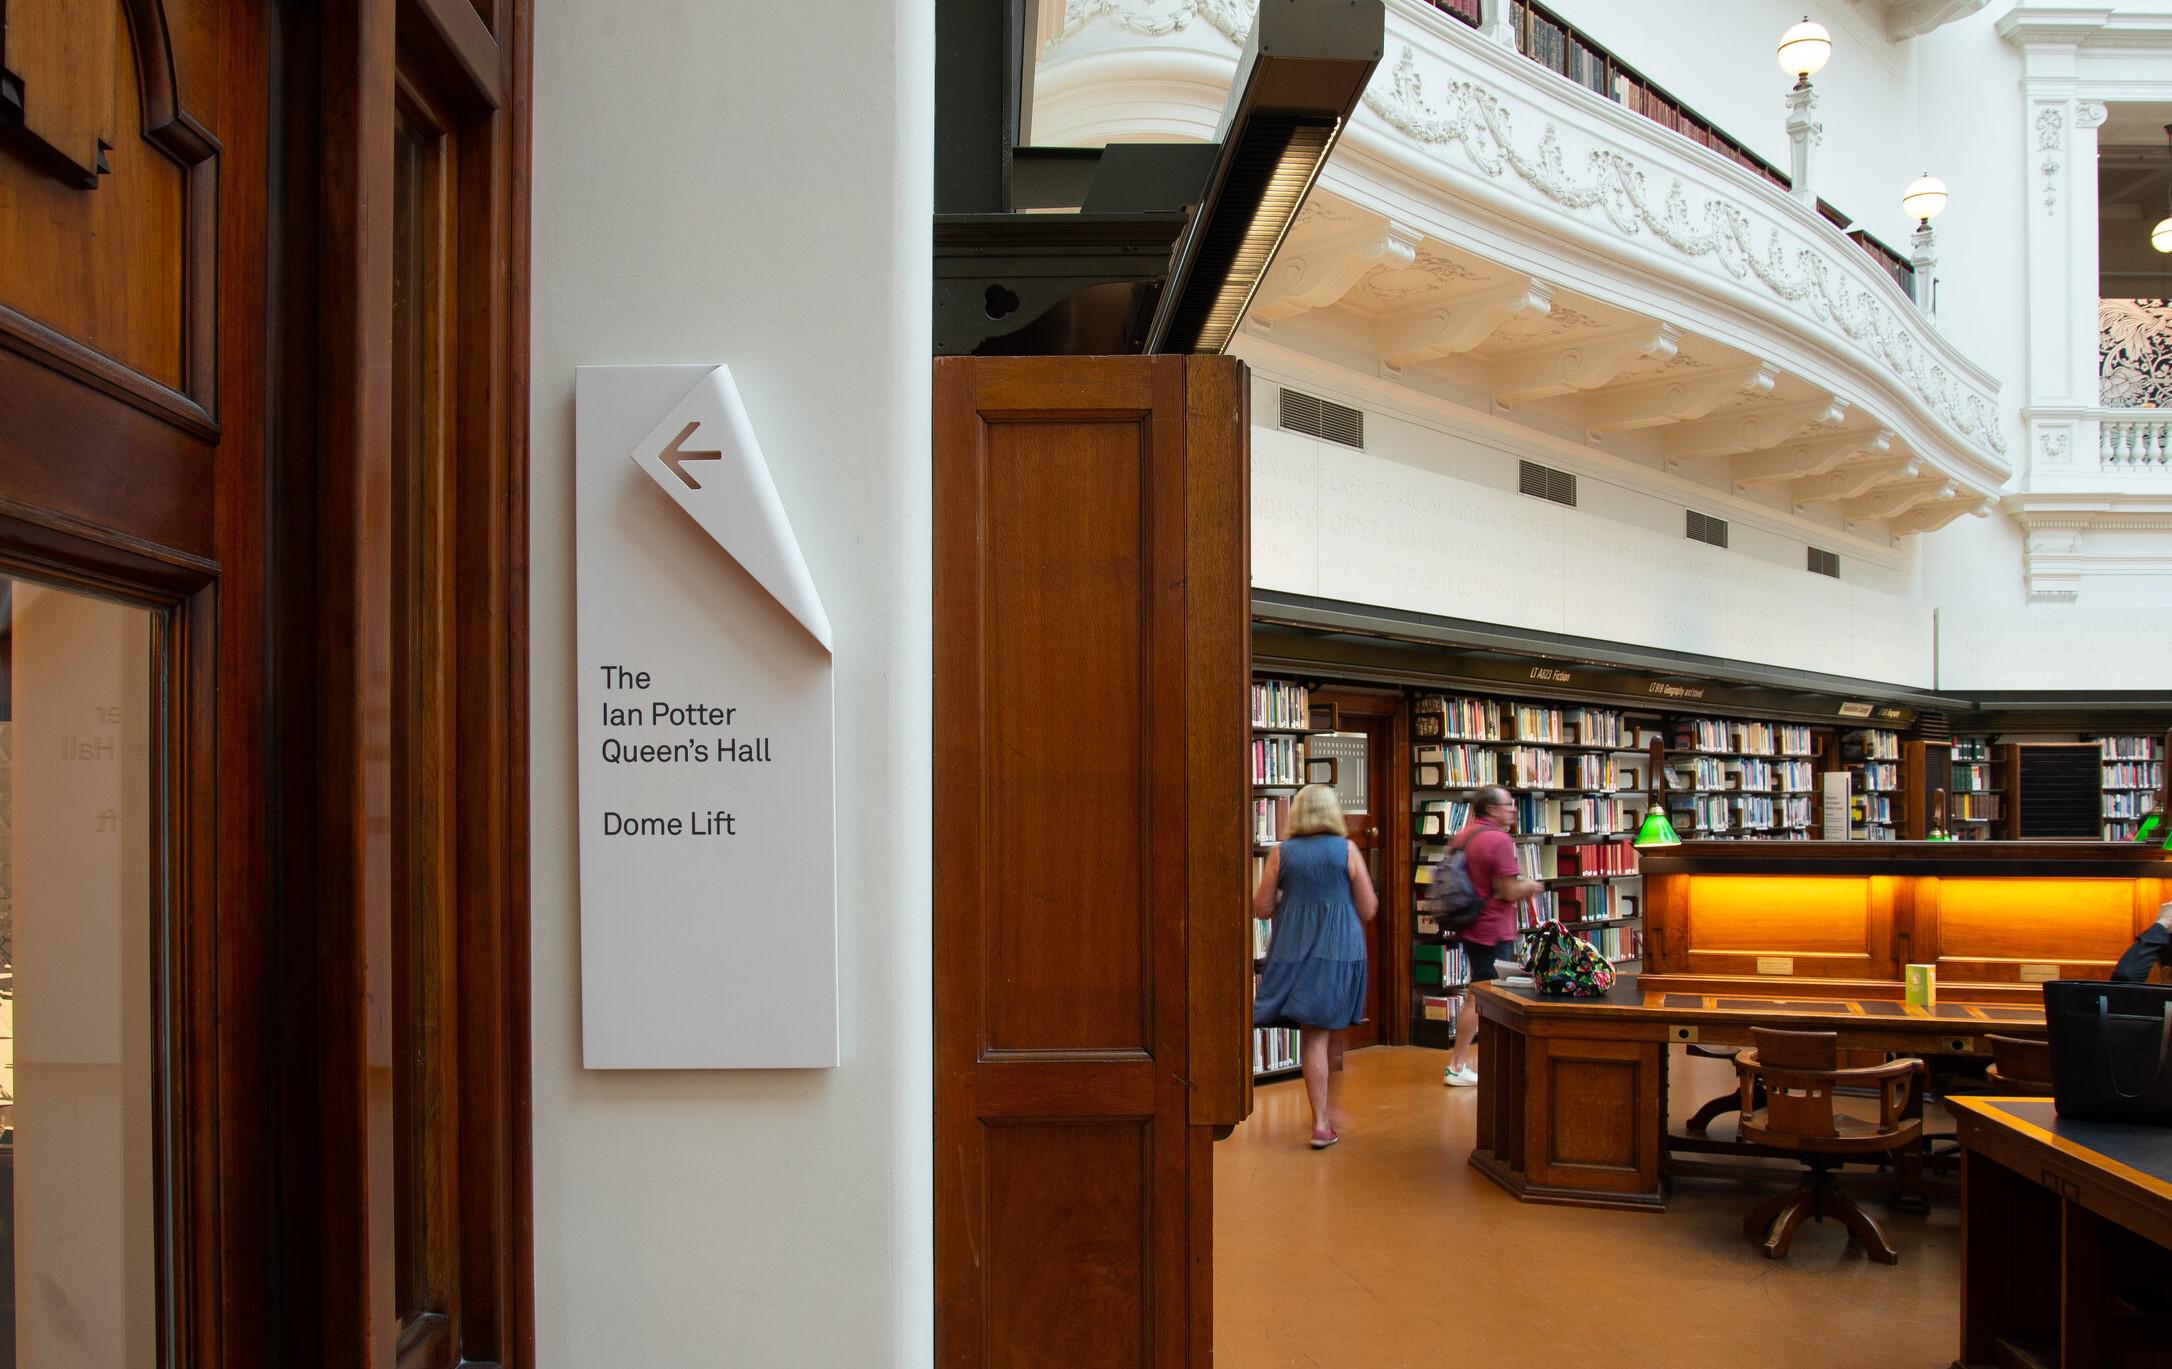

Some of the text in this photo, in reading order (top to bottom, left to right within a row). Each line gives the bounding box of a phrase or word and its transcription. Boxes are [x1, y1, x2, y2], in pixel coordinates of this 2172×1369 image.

[601, 666, 651, 690] The
[1552, 669, 1571, 682] Fiction
[603, 702, 737, 726] Ian Potter
[602, 737, 772, 764] Queen’s Hall
[604, 810, 736, 836] Dome Lift
